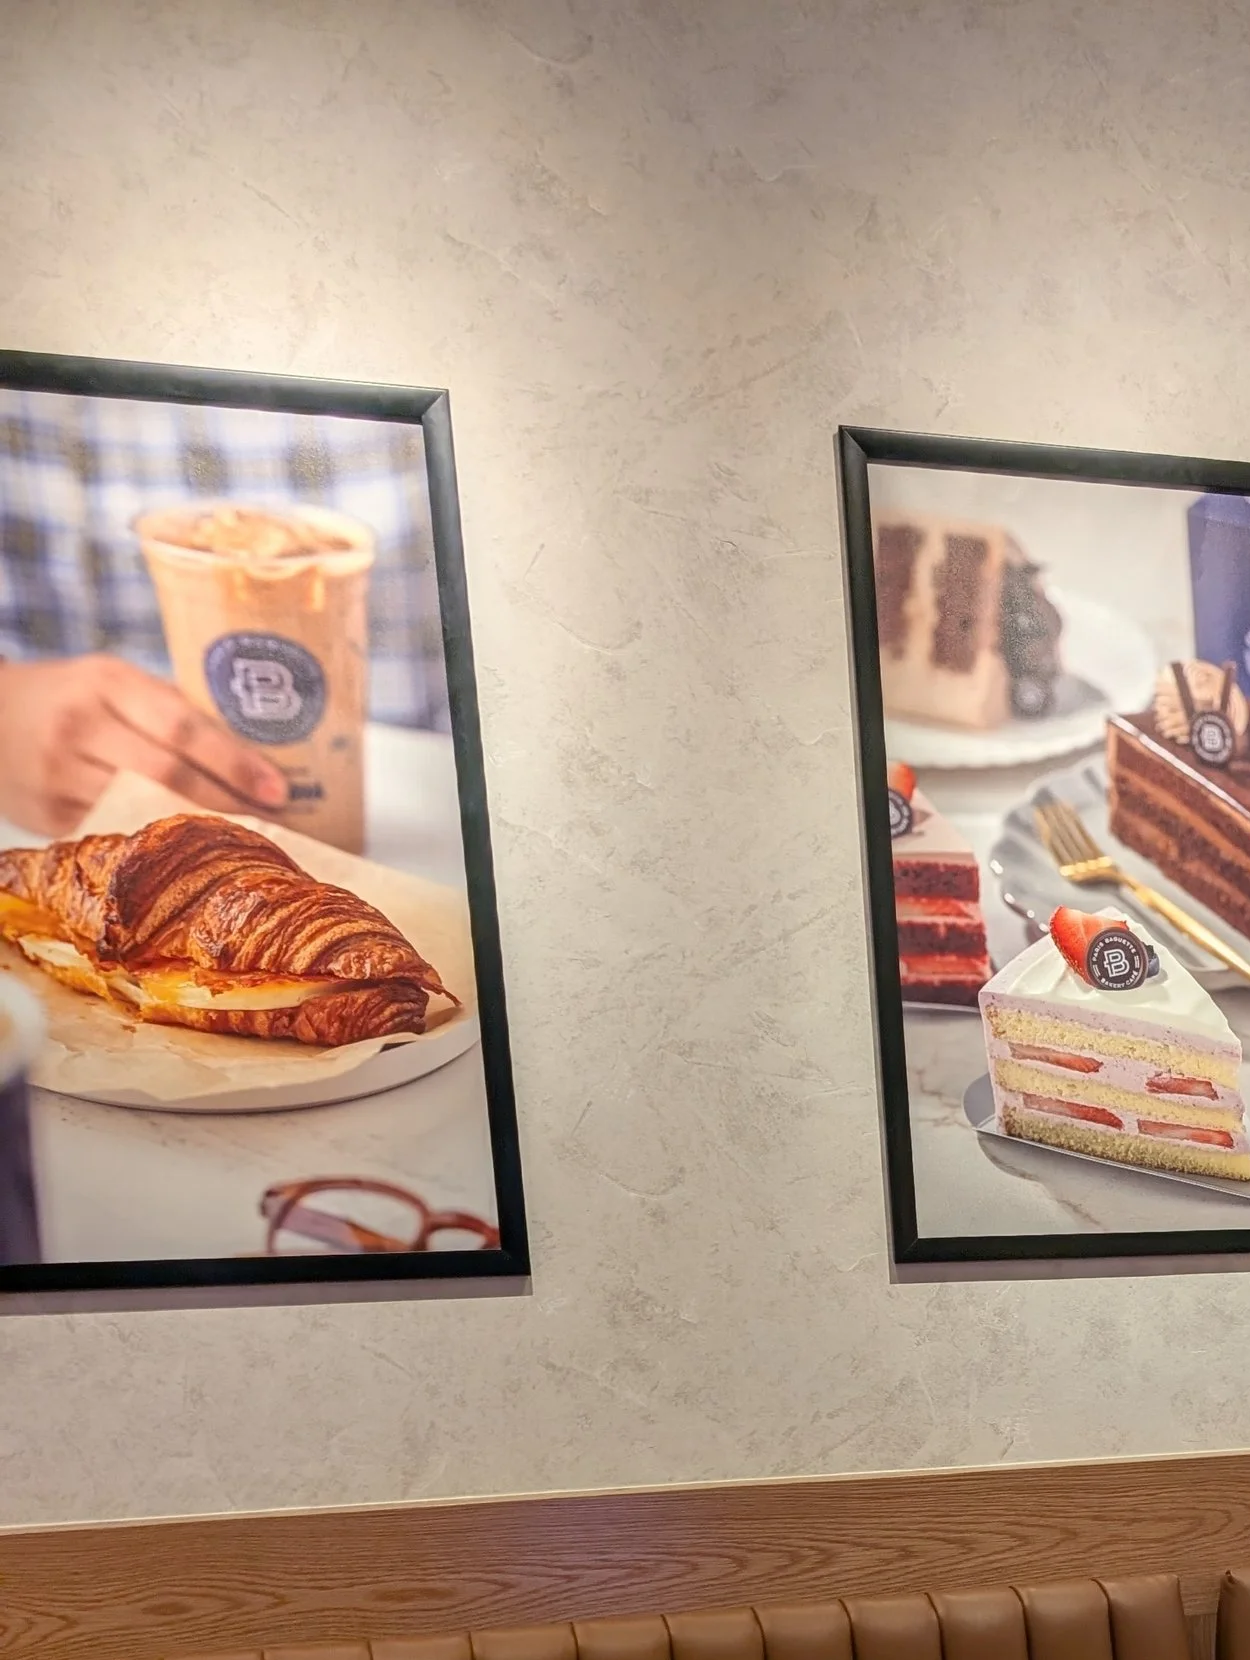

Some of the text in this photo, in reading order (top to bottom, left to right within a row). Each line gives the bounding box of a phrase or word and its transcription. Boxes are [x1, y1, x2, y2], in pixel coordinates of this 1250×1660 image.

[1092, 936, 1136, 961] PARIS BAGUETTE
[1100, 977, 1125, 988] BAKERY
